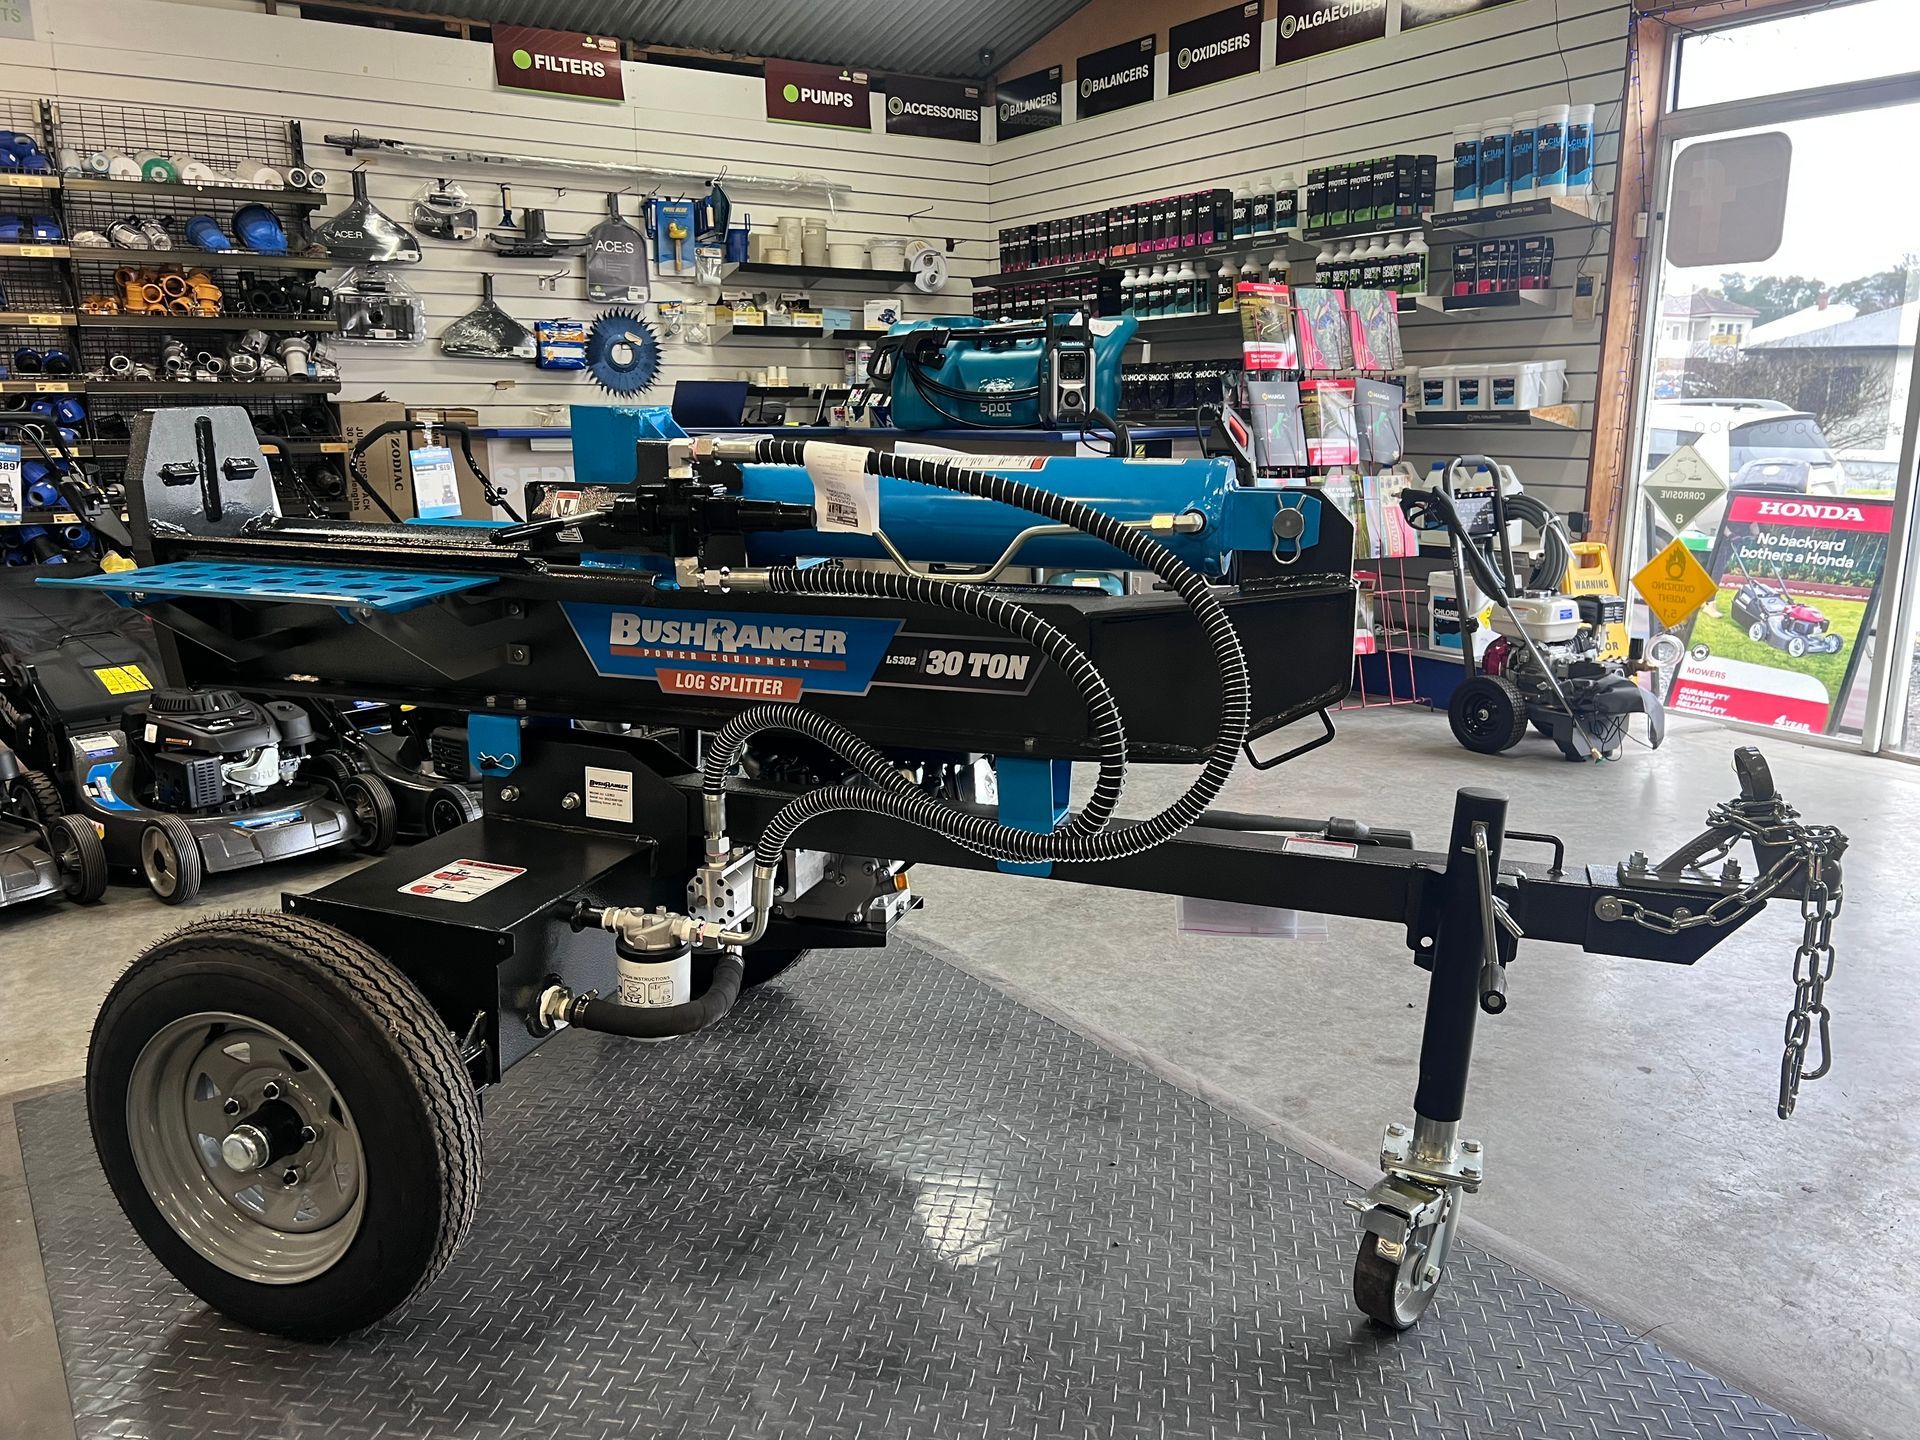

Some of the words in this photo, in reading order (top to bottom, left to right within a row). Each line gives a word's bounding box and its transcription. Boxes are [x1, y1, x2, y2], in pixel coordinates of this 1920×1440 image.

[1296, 0, 1381, 32] ALGAECIDES
[1192, 33, 1250, 63] OXIDISERS
[534, 54, 606, 78] FILTERS
[1092, 64, 1149, 92] BALANCERS
[801, 88, 854, 108] PUMPS
[1010, 92, 1057, 116] BALANCERS
[904, 102, 978, 122] ACCESSORIES
[1328, 178, 1348, 187] PROTEC
[1350, 176, 1370, 184] PROTEC
[1374, 172, 1394, 180] PROTEC
[595, 240, 634, 253] ACE:S
[1173, 372, 1192, 380] HOCK
[390, 438, 404, 491] ZODIAC
[362, 492, 370, 511] ACK
[1758, 501, 1865, 522] HONDA
[1757, 532, 1777, 546] No
[1779, 536, 1846, 552] backyard
[1740, 546, 1794, 562] bothers
[1795, 554, 1804, 563] a
[1806, 552, 1854, 568] Honda
[1574, 580, 1609, 590] WARNING
[644, 649, 696, 660] POWER
[712, 654, 811, 668] EQUIPMENT
[886, 655, 917, 666] LS302
[926, 650, 964, 676] 30
[968, 652, 1031, 680] TON
[1686, 666, 1726, 680] MOWERS
[675, 672, 706, 690] LOG
[710, 675, 784, 696] SPLITTER
[1680, 686, 1730, 701] DURABILITY
[1676, 700, 1727, 714] RELIABILITY
[1678, 694, 1714, 705] QUALITY
[1774, 714, 1786, 726] 4
[1784, 720, 1810, 730] YEAR
